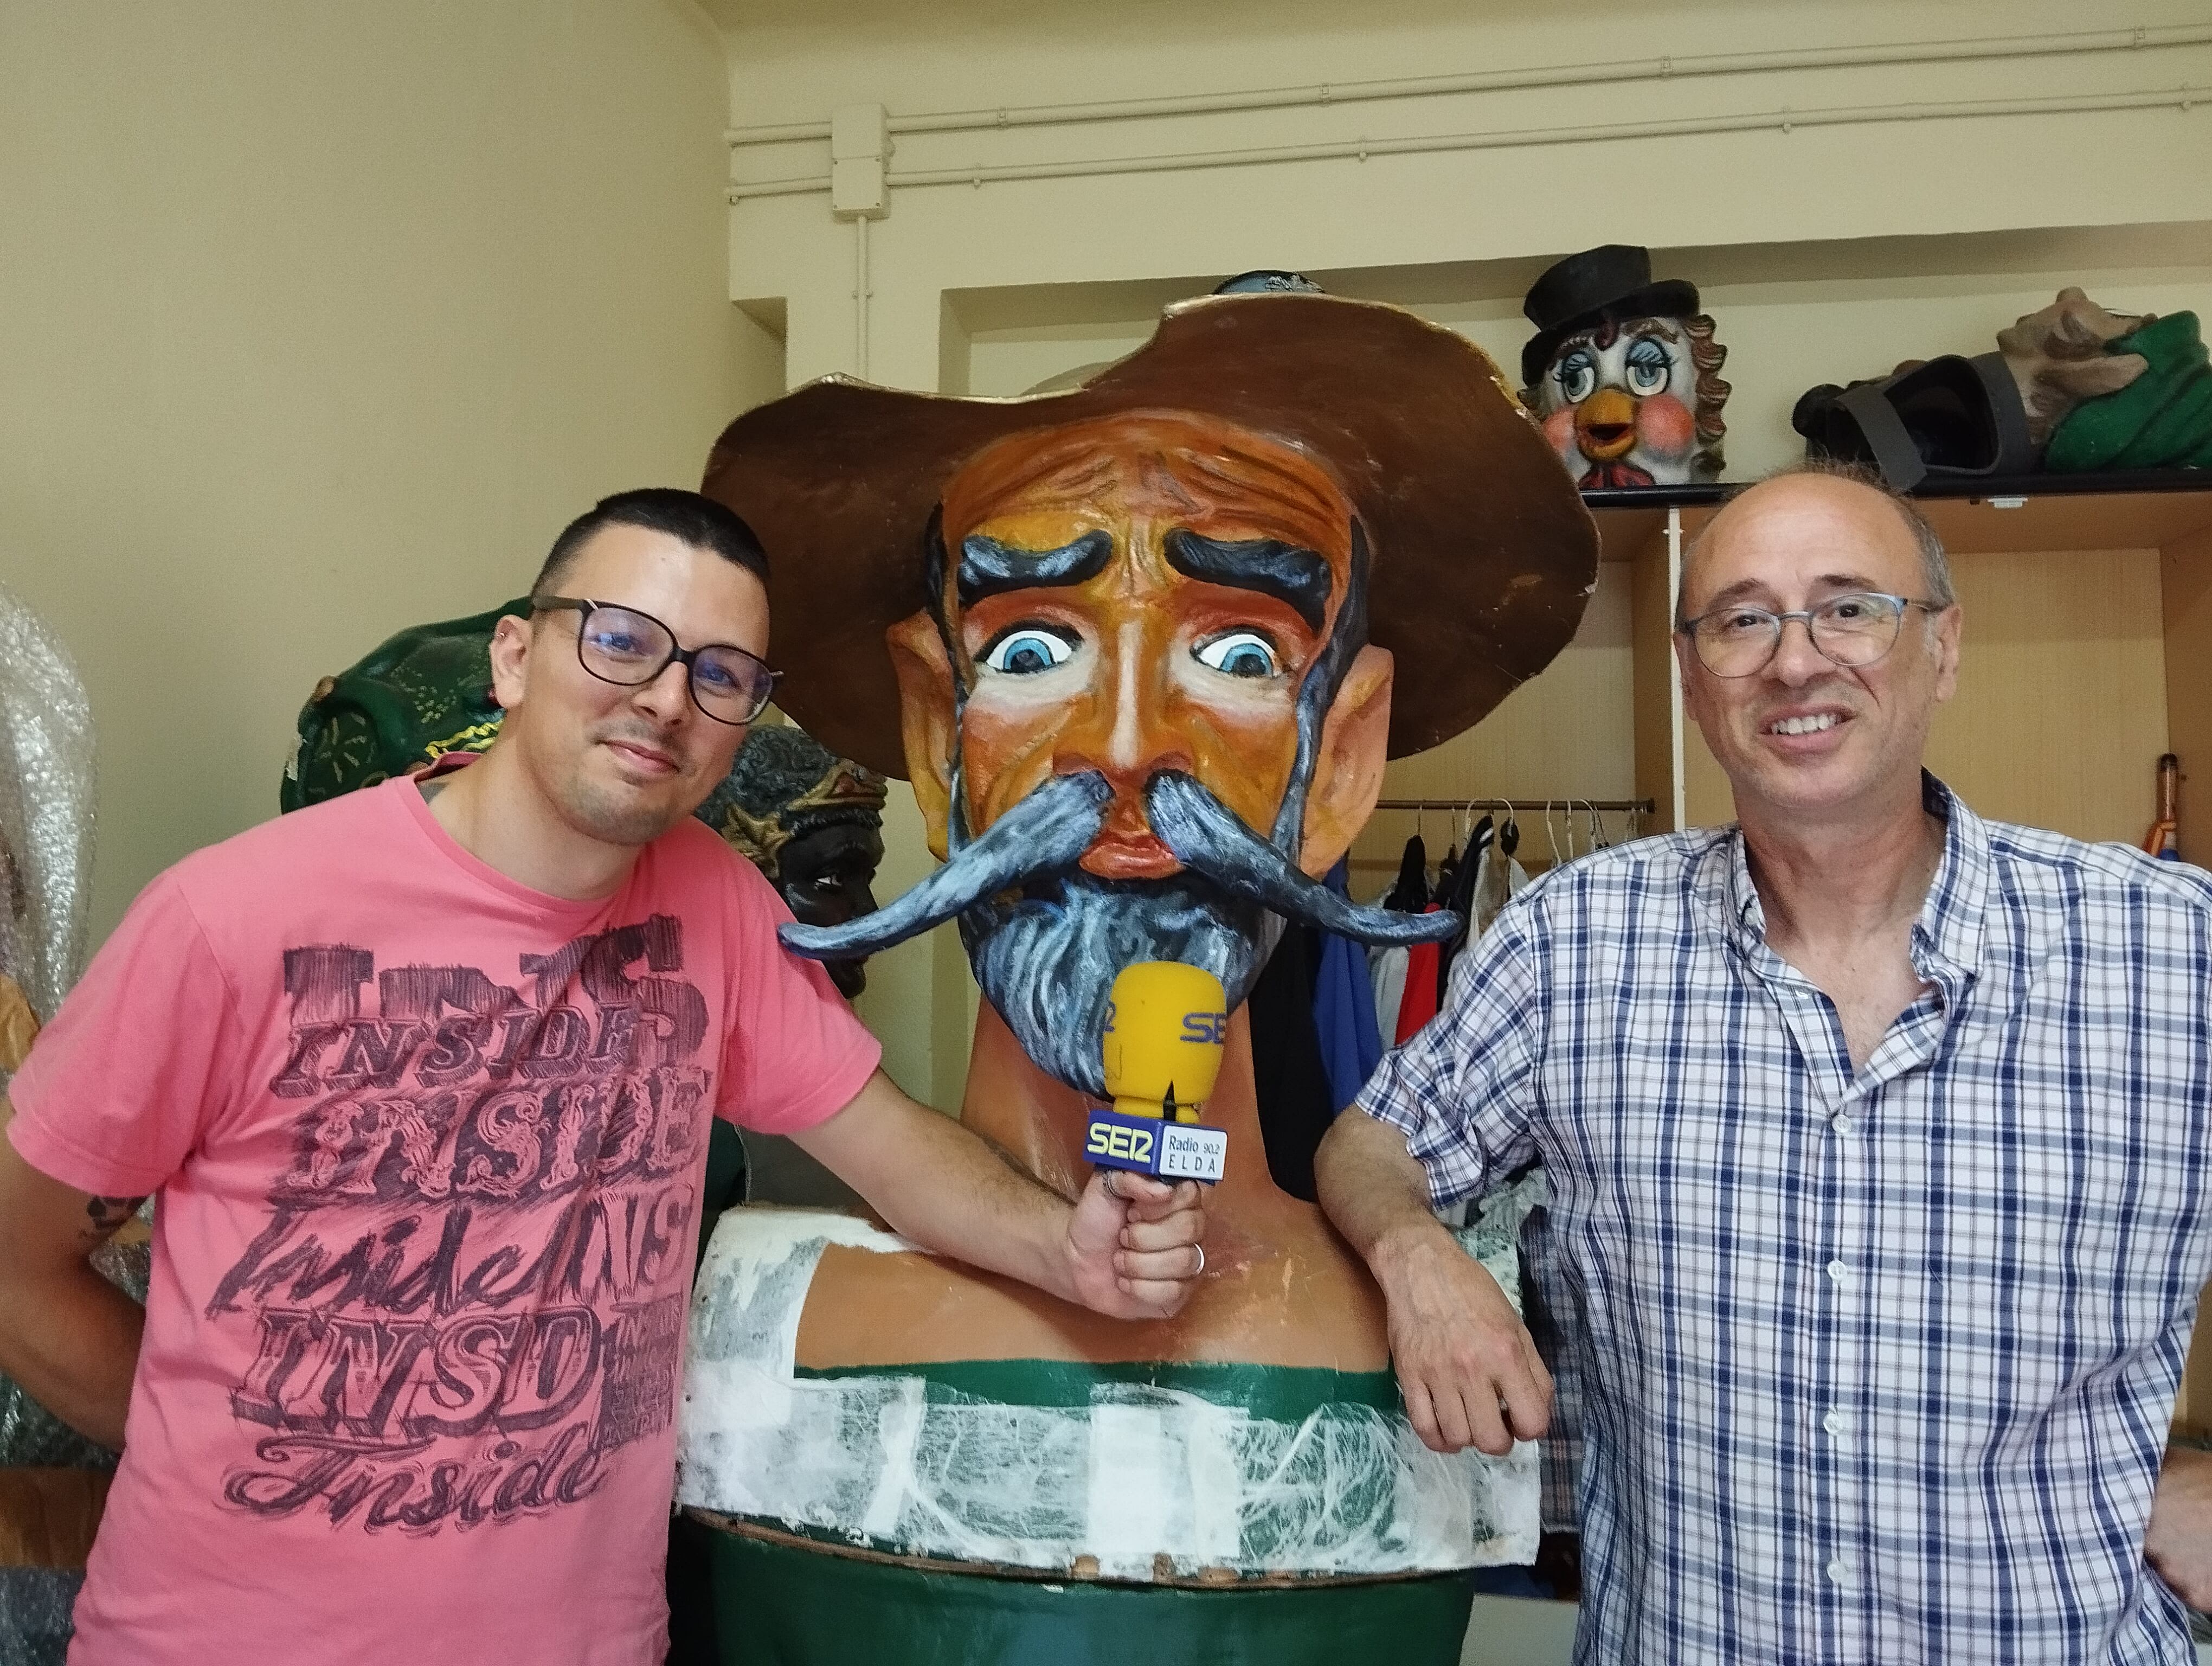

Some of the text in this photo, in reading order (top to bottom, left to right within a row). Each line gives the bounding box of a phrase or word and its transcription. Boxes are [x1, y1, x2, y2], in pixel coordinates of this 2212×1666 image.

[1086, 1122, 1154, 1164] SER
[1169, 1135, 1199, 1152] Radio
[1169, 1153, 1216, 1173] ELDA
[219, 1418, 608, 1537] Inside
